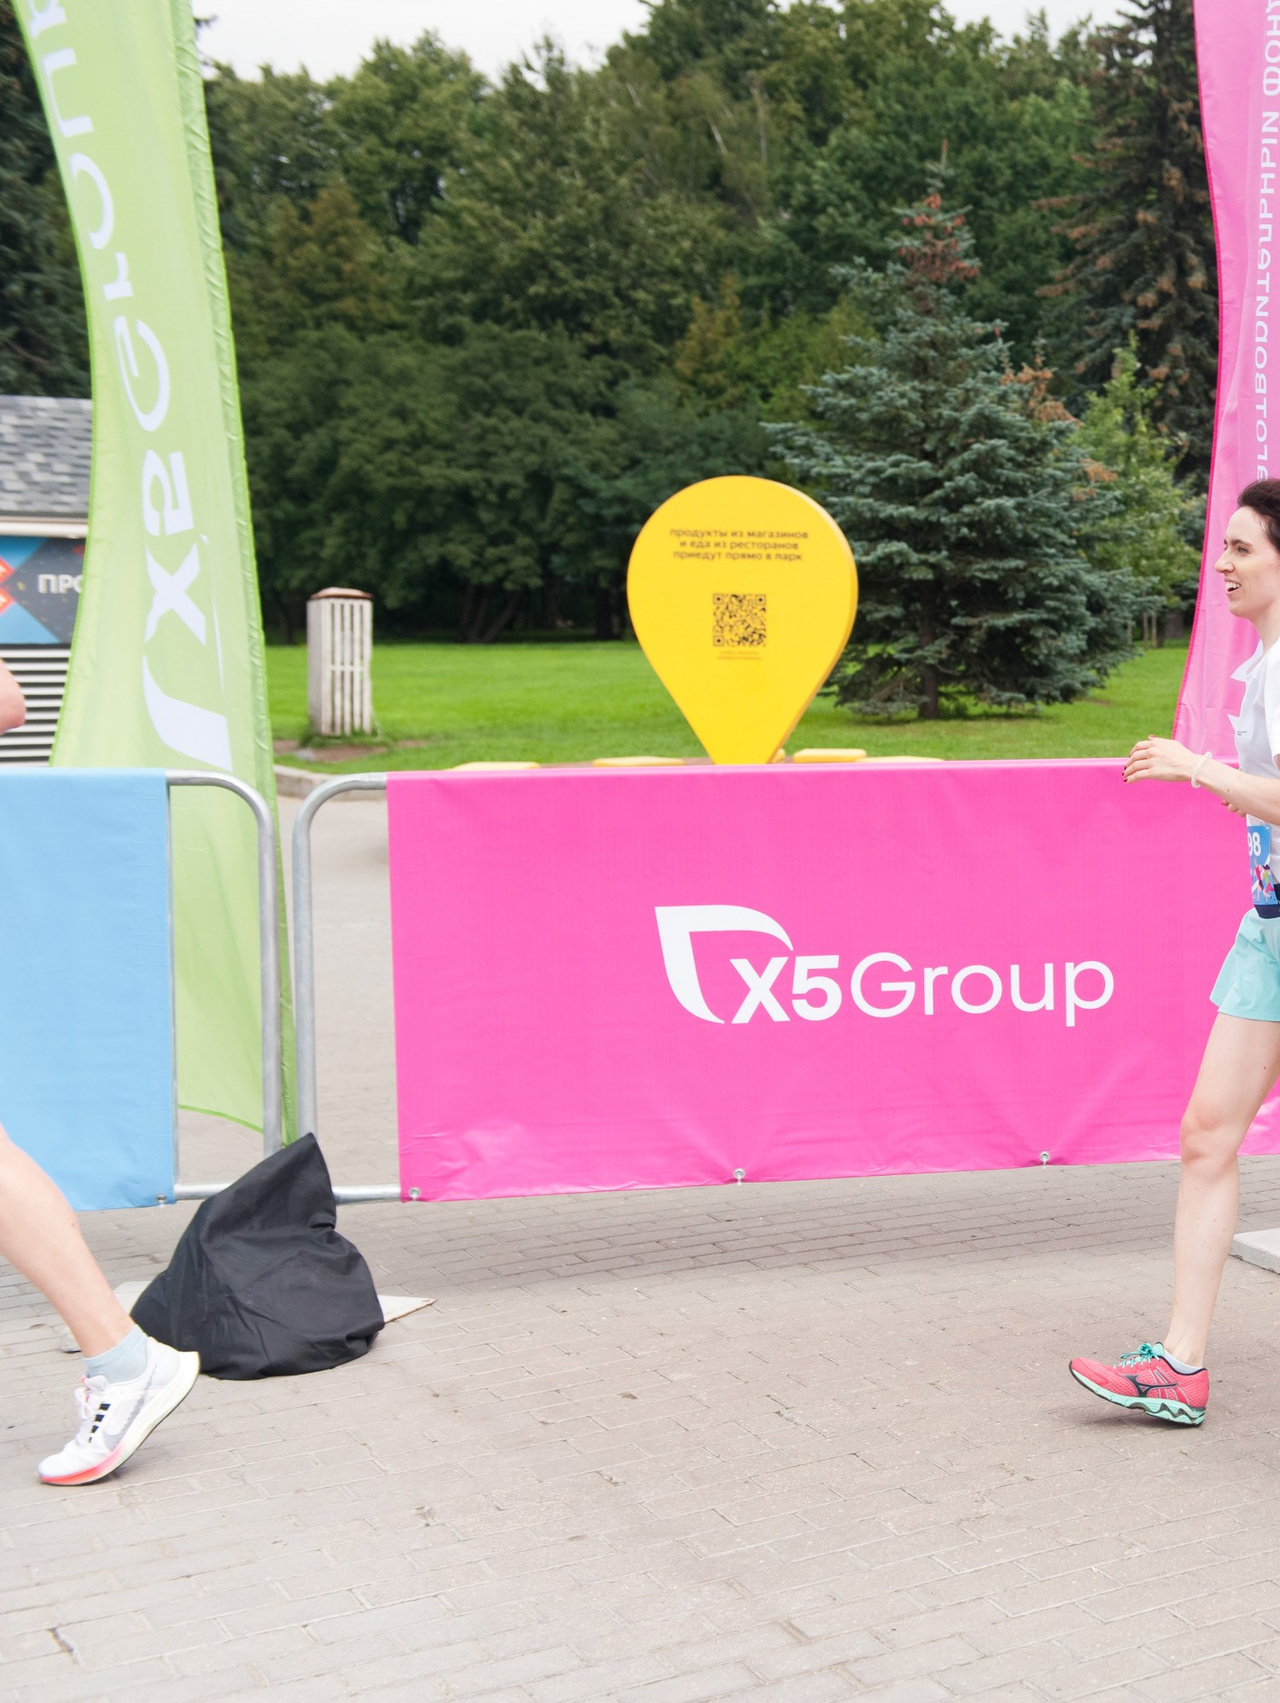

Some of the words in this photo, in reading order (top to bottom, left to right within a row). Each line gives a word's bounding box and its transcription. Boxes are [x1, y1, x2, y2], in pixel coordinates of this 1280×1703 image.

[669, 528, 728, 539] продукты
[730, 530, 744, 538] из
[747, 530, 809, 539] магазинов
[690, 540, 711, 549] еда
[713, 540, 727, 548] из
[729, 541, 799, 550] ресторанов
[673, 550, 722, 561] приедут
[725, 551, 763, 561] прямо
[774, 552, 803, 562] парк
